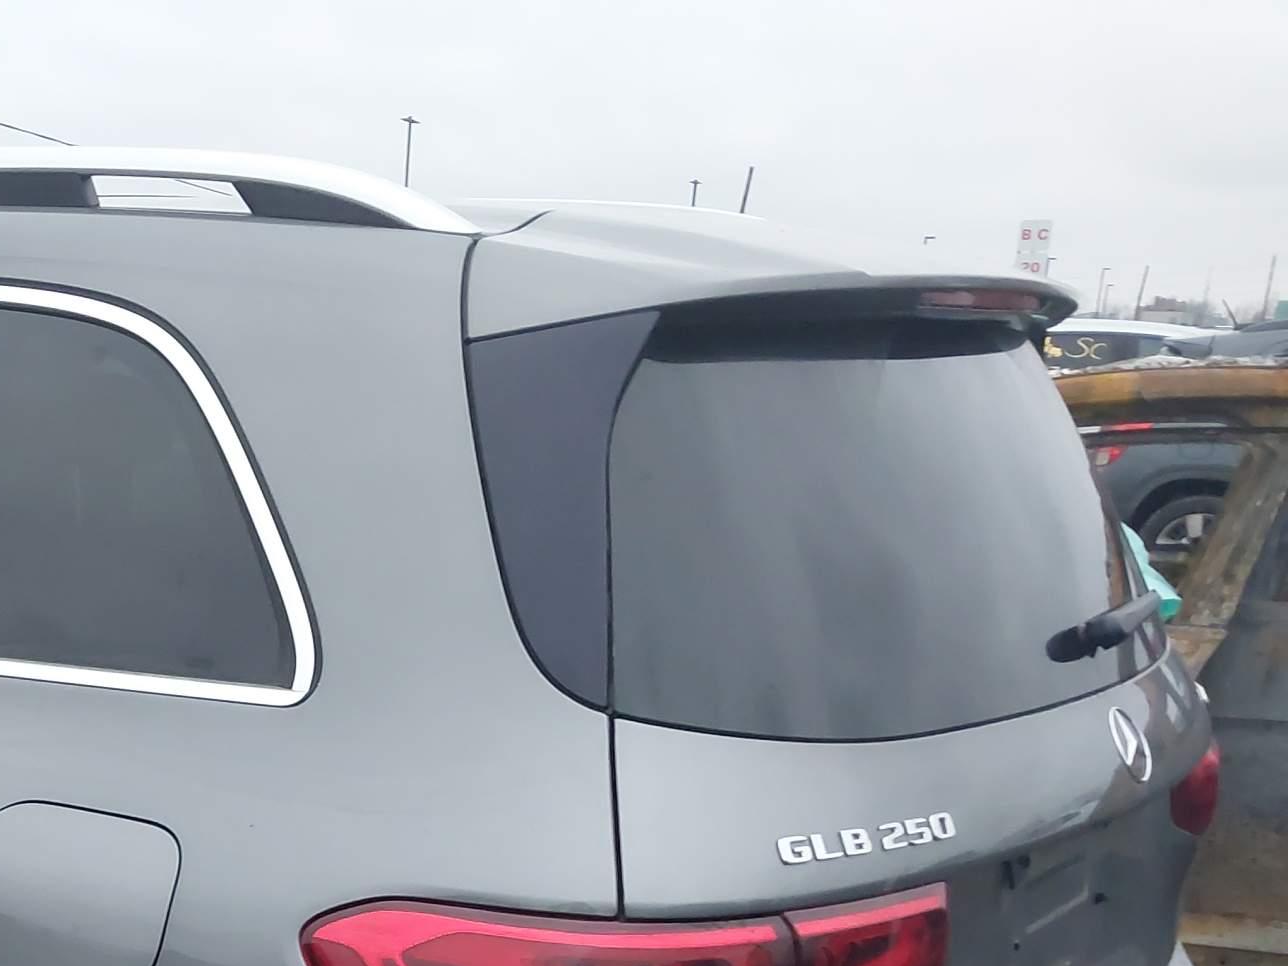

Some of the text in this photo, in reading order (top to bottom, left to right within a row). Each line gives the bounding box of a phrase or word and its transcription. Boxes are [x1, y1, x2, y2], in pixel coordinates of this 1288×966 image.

[1021, 228, 1049, 240] B C
[777, 812, 957, 865] GLB 250
